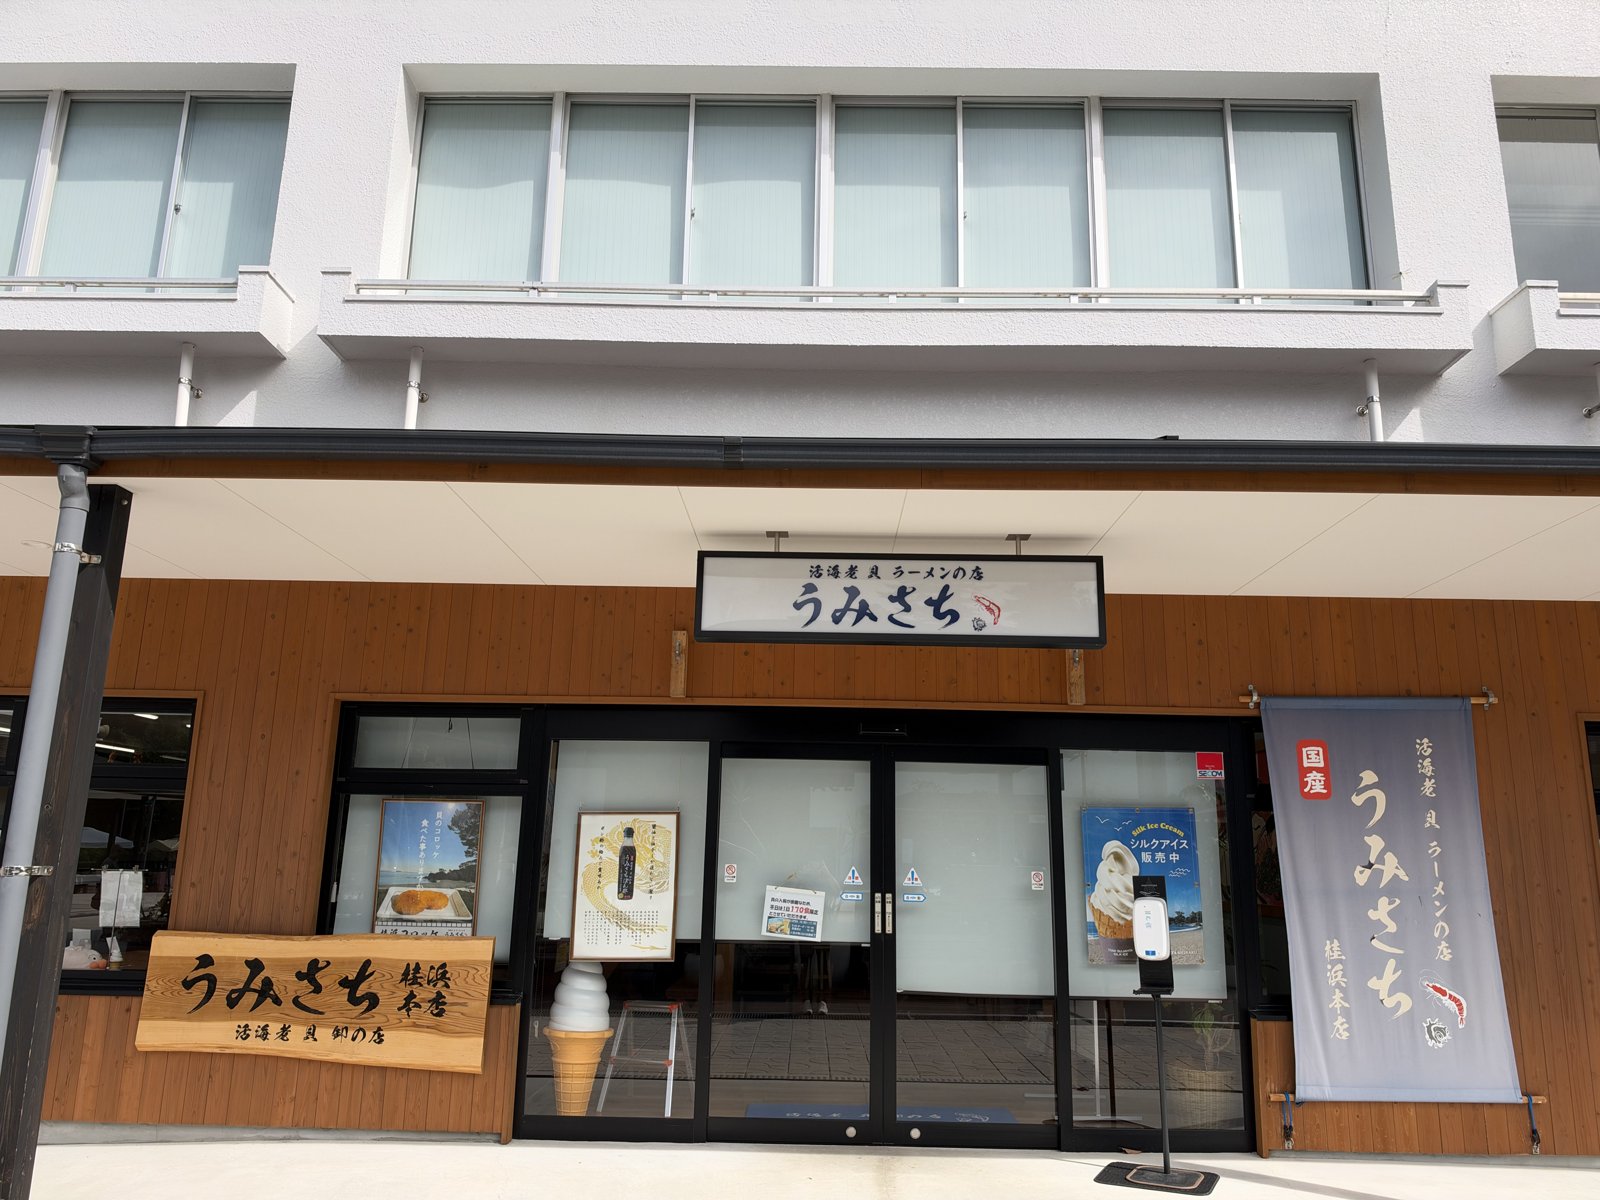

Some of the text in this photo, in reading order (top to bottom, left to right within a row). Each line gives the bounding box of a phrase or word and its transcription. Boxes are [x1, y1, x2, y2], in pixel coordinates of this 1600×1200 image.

[809, 564, 984, 581] 活海老 貝 ラーメンの店
[792, 582, 961, 629] うみさち
[1301, 746, 1328, 794] 国産
[433, 811, 443, 859] 貝のコロッケ
[1130, 838, 1189, 850] シルクアイス
[1131, 826, 1147, 837] Silk
[1160, 822, 1185, 837] Cream
[1141, 851, 1180, 864] 販売中
[1415, 737, 1453, 961] 活海老 貝 ラーメンの店
[1351, 769, 1413, 1022] うみさち
[181, 953, 380, 1016] うみさち
[399, 961, 451, 988] 桂浜
[1324, 938, 1351, 1041] 桂浜本店
[397, 990, 447, 1018] 本店
[235, 1023, 385, 1045] 活海老 貝 卸の店
